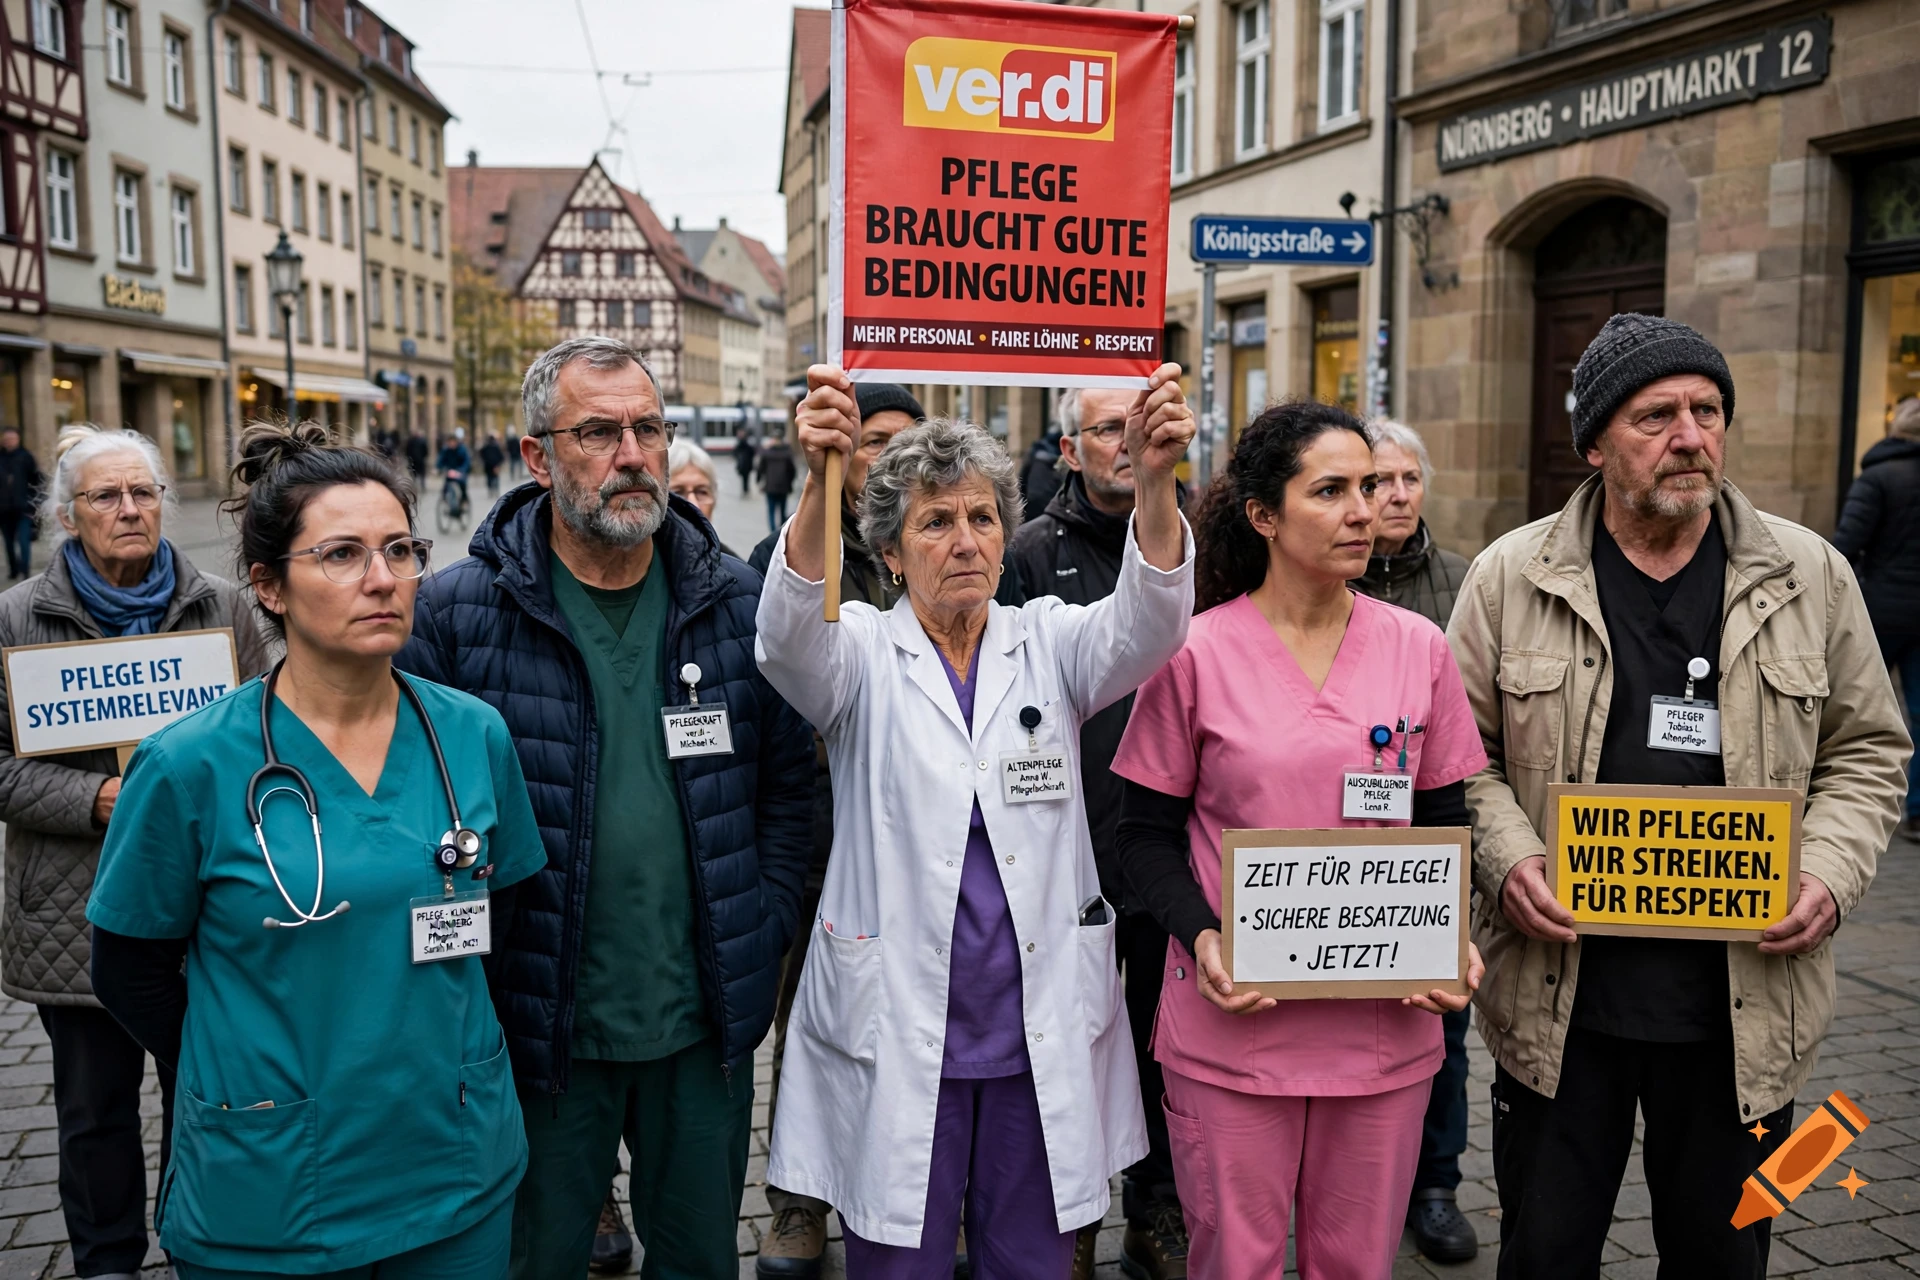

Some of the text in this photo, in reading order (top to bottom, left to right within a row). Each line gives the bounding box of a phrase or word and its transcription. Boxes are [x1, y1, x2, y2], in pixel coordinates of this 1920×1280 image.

[913, 60, 1104, 124] ver.di
[1441, 29, 1814, 162] NÜRNBERG HAUPTMARKT 12
[941, 157, 1078, 203] PFLEGE
[866, 204, 1147, 258] BRAUCHT GUTE
[1203, 225, 1335, 258] Königsstraße
[865, 257, 1146, 309] BEDINGUNGEN!
[852, 325, 1154, 352] MEHR PERSONAL FAIRE LÖHNE RESPEKT
[60, 657, 182, 693] PFLEGE IST
[669, 715, 722, 728] PFLEGEKRAFT
[1667, 710, 1704, 722] PFLEGER
[680, 737, 718, 748] Michael K.
[1007, 759, 1063, 772] ALTENPFLEGE
[1041, 771, 1052, 781] W.
[1364, 790, 1391, 800] PFLEGE
[1365, 802, 1382, 811] Lena
[1384, 803, 1391, 811] R.
[1572, 807, 1775, 842] WIR PFLEGEN.
[1244, 856, 1451, 888] ZEIT FÜR PFLEGE!
[1567, 845, 1780, 881] WIR STREIKEN.
[1572, 878, 1771, 919] FÜR RESPEKT!
[416, 910, 444, 921] PFLEGE
[1252, 904, 1450, 931] SICHERE BESATZUNG
[1307, 941, 1399, 970] JETZT!
